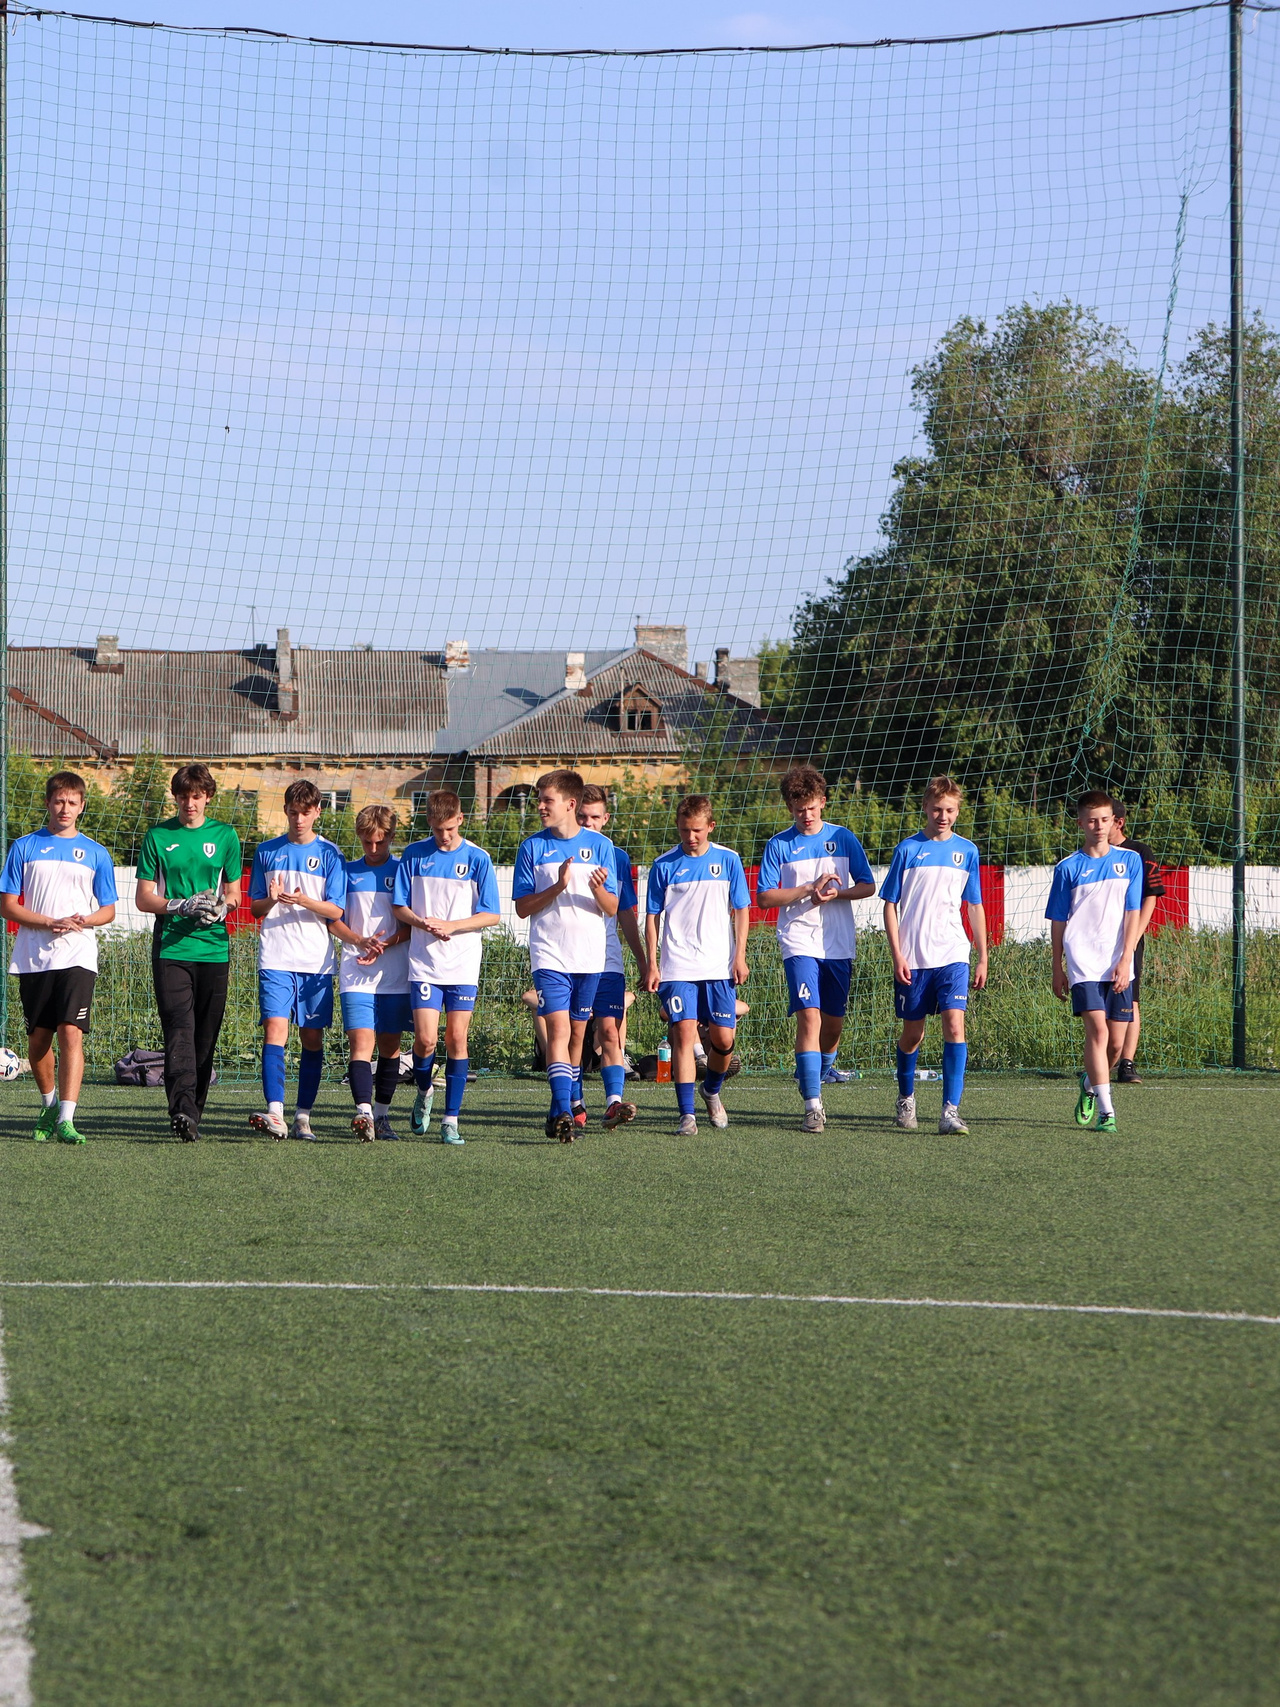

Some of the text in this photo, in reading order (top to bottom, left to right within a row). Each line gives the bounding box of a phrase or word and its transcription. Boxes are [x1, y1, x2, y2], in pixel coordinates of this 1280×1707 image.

[420, 982, 431, 1001] 9
[537, 989, 545, 1008] 3
[798, 982, 811, 1001] 4
[666, 995, 683, 1015] 10
[899, 994, 906, 1012] 7
